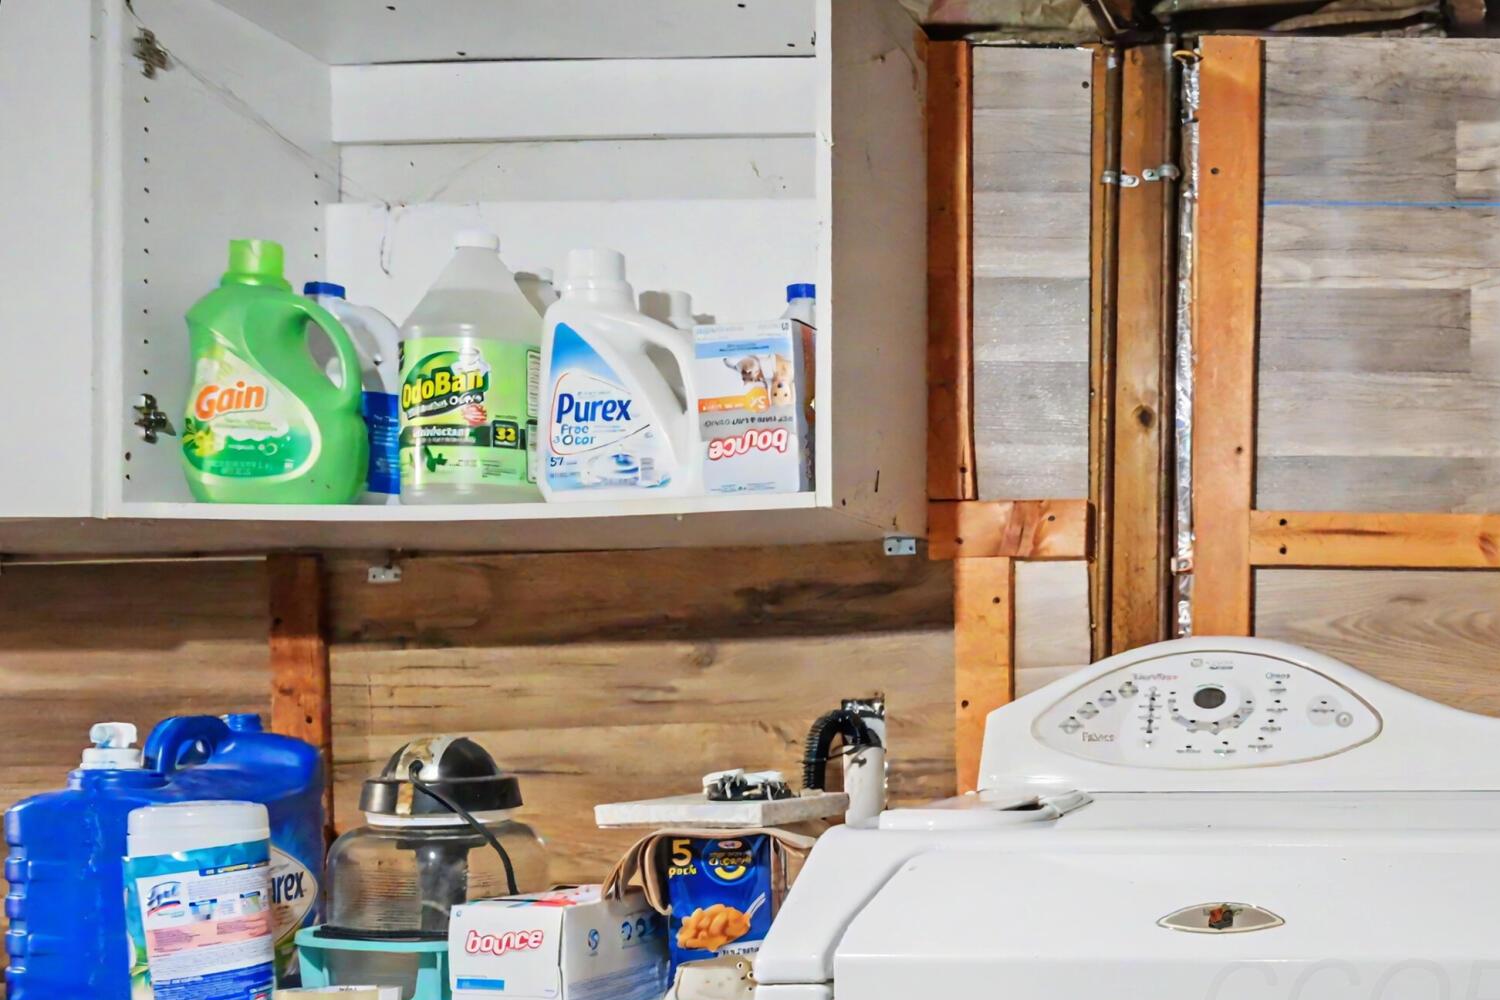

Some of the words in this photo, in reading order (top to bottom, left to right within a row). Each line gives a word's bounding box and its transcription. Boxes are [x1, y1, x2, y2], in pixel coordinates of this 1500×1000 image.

[194, 380, 266, 420] Gain
[402, 371, 484, 408] OdoBan
[555, 392, 632, 424] Purex
[707, 428, 788, 461] bounce
[671, 838, 692, 867] 5
[272, 871, 305, 904] rex
[465, 929, 544, 956] bounce
